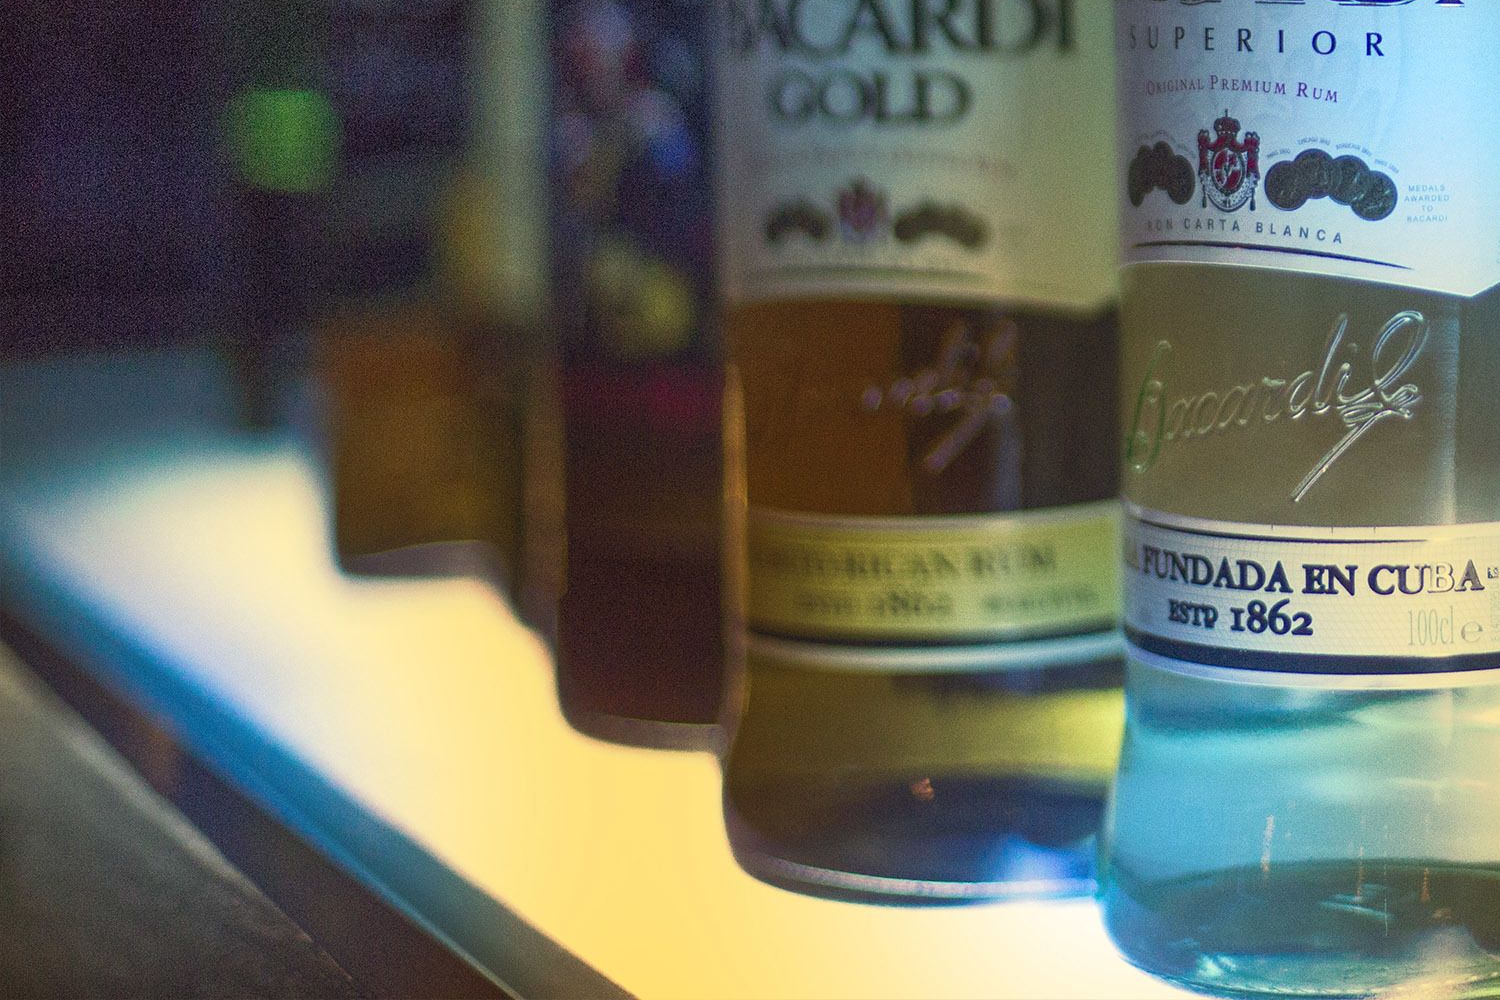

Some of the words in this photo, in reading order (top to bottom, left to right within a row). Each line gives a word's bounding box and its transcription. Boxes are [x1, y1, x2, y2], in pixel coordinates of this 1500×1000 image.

[1129, 25, 1386, 58] SUPERIOR
[772, 71, 975, 128] GOLD
[1403, 193, 1451, 203] AWARDED
[1407, 184, 1446, 193] MEDALS
[1406, 214, 1448, 224] BACARDI
[1421, 204, 1434, 213] TO
[1182, 216, 1241, 232] CARTA
[1254, 220, 1345, 245] BLANCA
[1141, 545, 1294, 595] FUNDADA
[1301, 563, 1357, 597] EN
[1367, 558, 1486, 595] CUBA
[1230, 598, 1315, 637] 1862
[1407, 604, 1456, 647] 100cl
